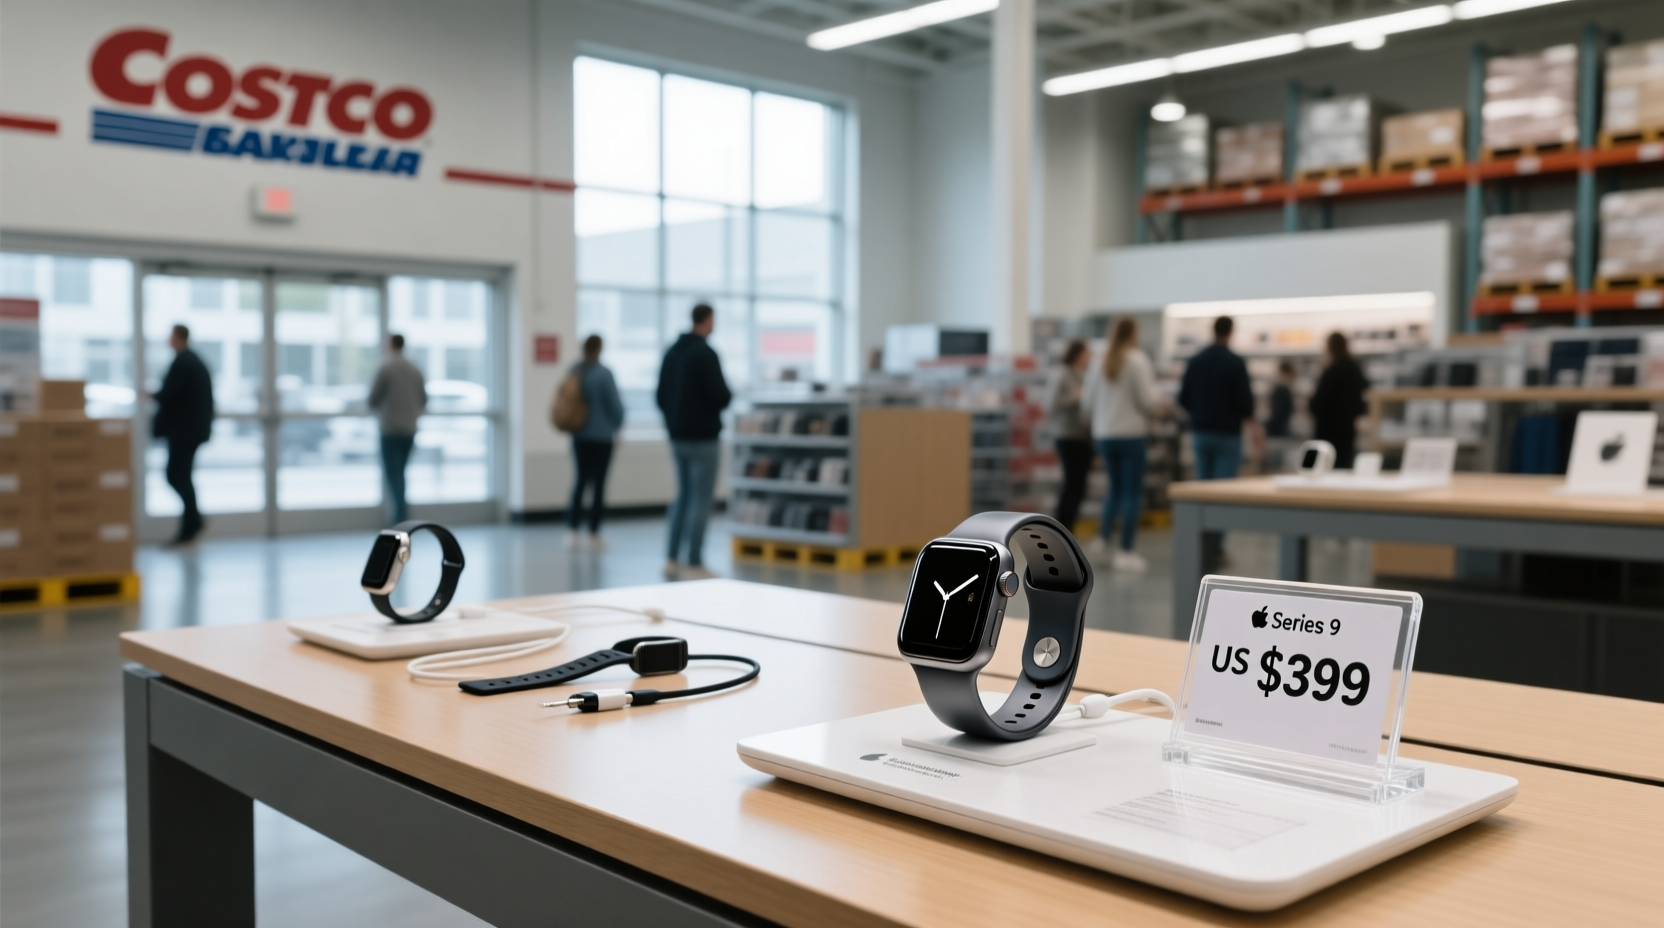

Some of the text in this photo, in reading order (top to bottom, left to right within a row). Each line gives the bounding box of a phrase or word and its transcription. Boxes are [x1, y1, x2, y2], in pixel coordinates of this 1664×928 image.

[90, 28, 433, 141] COSTCO
[1272, 612, 1341, 636] Series 9
[1211, 644, 1371, 707] US $399
